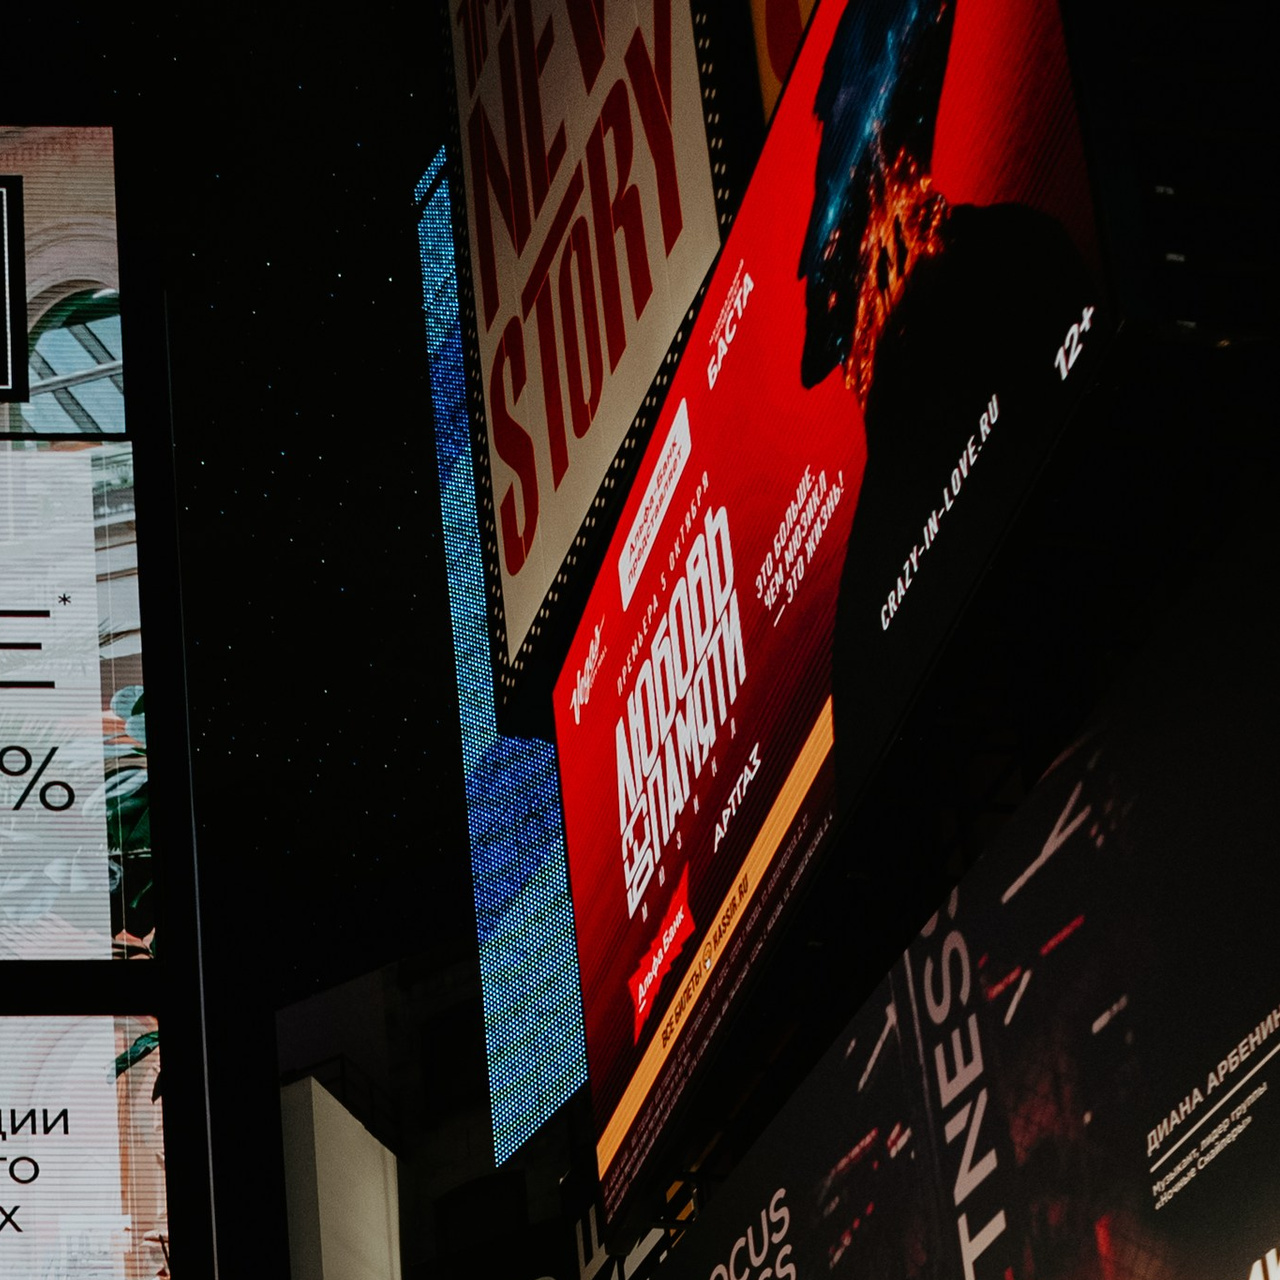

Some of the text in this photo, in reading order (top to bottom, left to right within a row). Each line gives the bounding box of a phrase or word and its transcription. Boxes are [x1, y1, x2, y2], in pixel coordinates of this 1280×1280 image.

[488, 0, 685, 577] STORY
[707, 272, 754, 390] БАСТА
[1054, 306, 1095, 381] 12+
[627, 446, 683, 585] представляет
[628, 436, 678, 560] Альфа-Банк
[764, 470, 827, 611] ЧЕМ МЮЗИКЛ
[785, 558, 805, 604] ЭТО
[806, 470, 845, 565] ЖИЗНЬ!
[881, 394, 1001, 631] CRAZY-IN-LOVE.RU
[617, 470, 709, 696] ПРЕМЬЕРА 5 ОКТЯБРЯ
[755, 555, 773, 599] ЭТО
[616, 505, 735, 836] ЛЮБОВЬ
[646, 588, 747, 864] ПАМЯТИ
[621, 792, 654, 920] БЕЗ
[713, 742, 762, 854] АРТГАЗ
[637, 904, 685, 1012] Альфа Банк
[661, 873, 749, 1049] ВСЕ БИЛЕТЫ KASSIR.RU
[1146, 1087, 1204, 1158] ДИАНА
[1151, 1147, 1201, 1197] Музыкант,
[1229, 1081, 1268, 1126] группы
